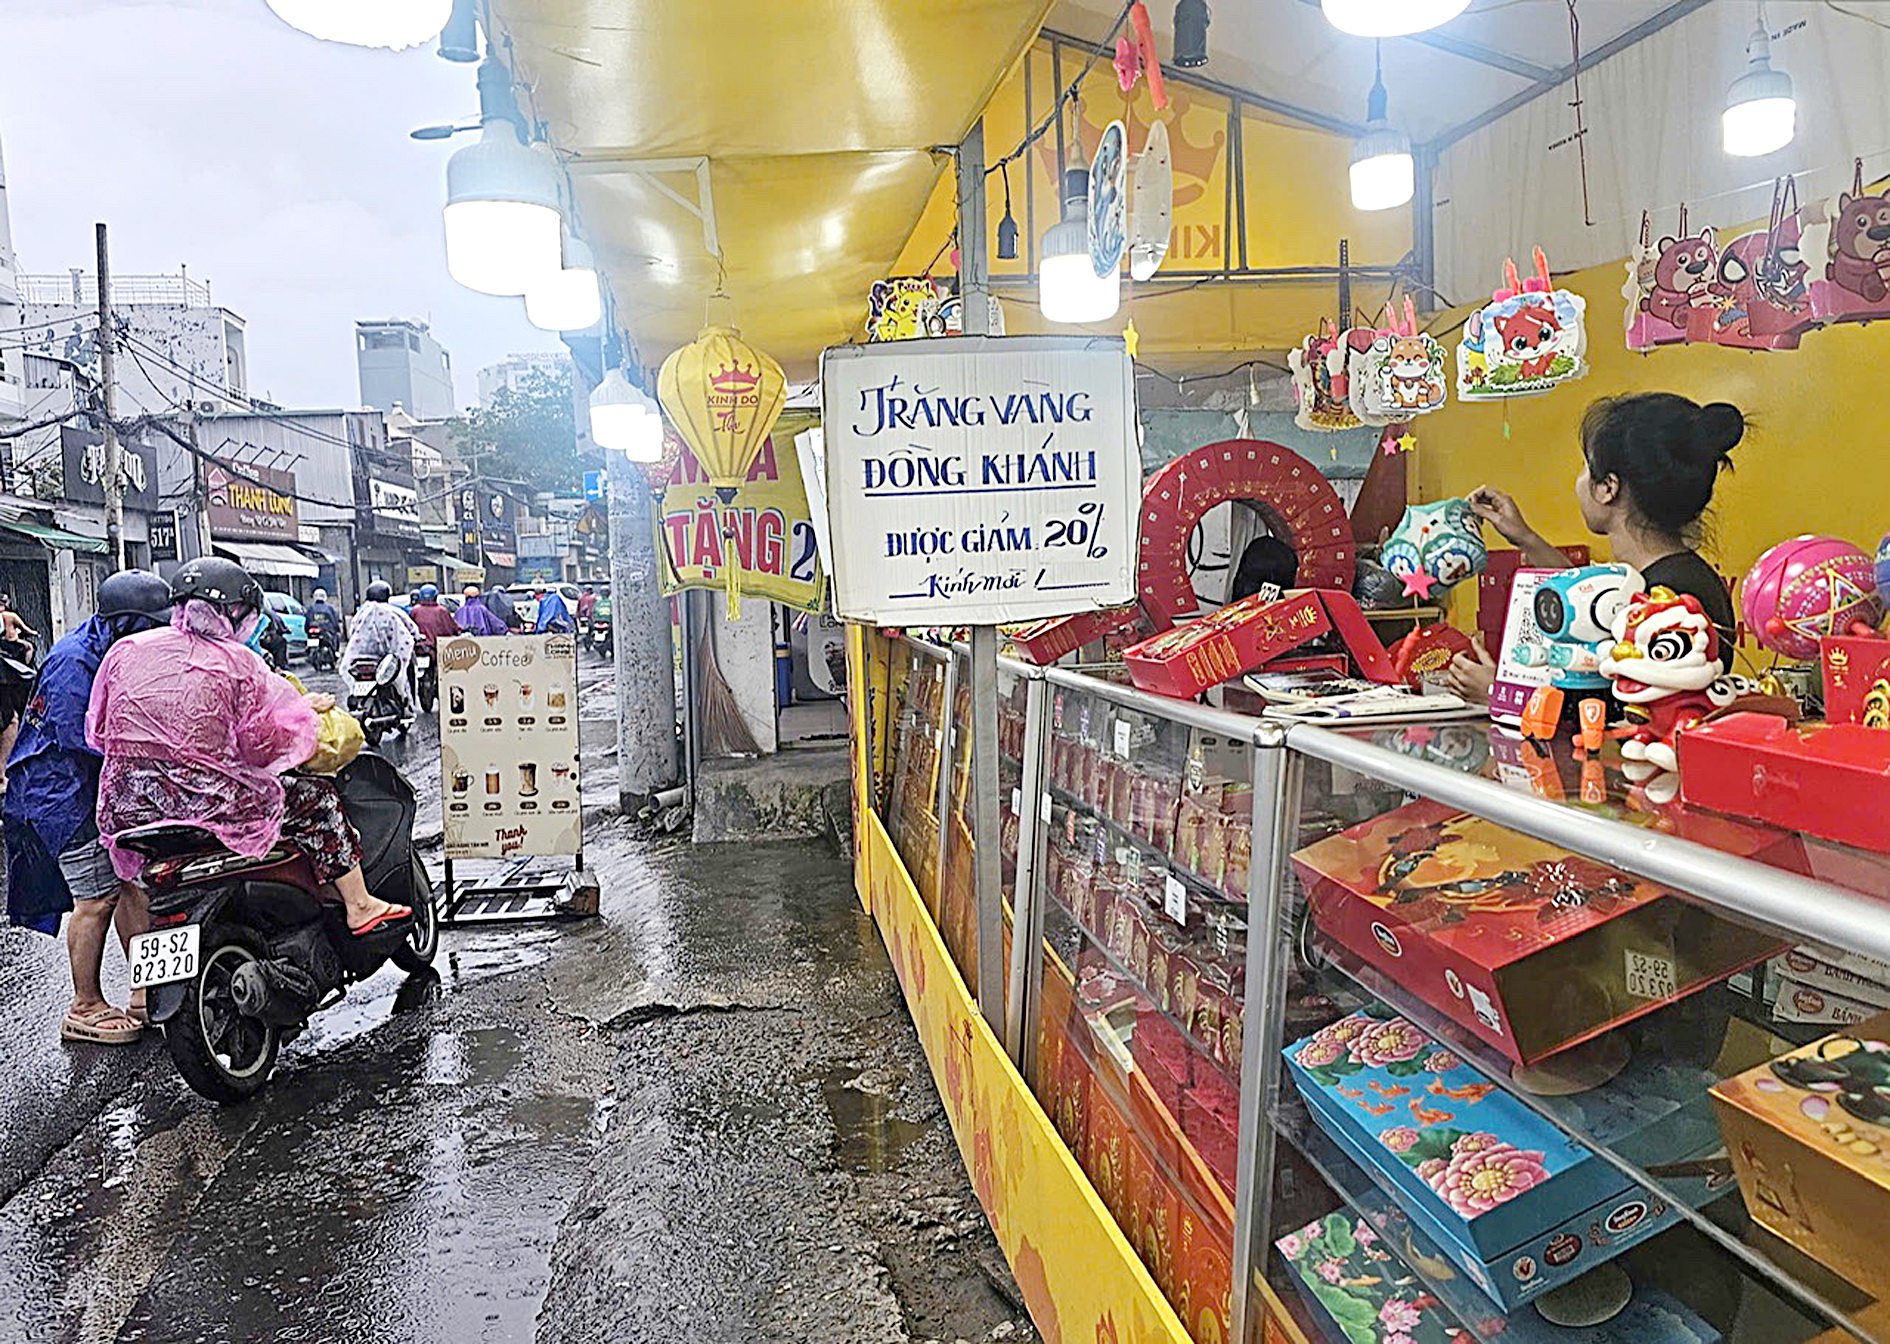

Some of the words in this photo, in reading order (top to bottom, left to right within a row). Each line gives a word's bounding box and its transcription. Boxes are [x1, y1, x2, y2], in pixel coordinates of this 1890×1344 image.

[853, 375, 985, 436] TRĂNG
[862, 443, 967, 489] ĐỒNG
[981, 432, 1096, 485] KHÁNH
[666, 496, 784, 579] TẶNG
[1043, 502, 1109, 559] 20%
[443, 647, 477, 661] Menu
[481, 650, 530, 667] Coffee
[495, 824, 527, 841] Thank
[133, 953, 194, 984] 823.20
